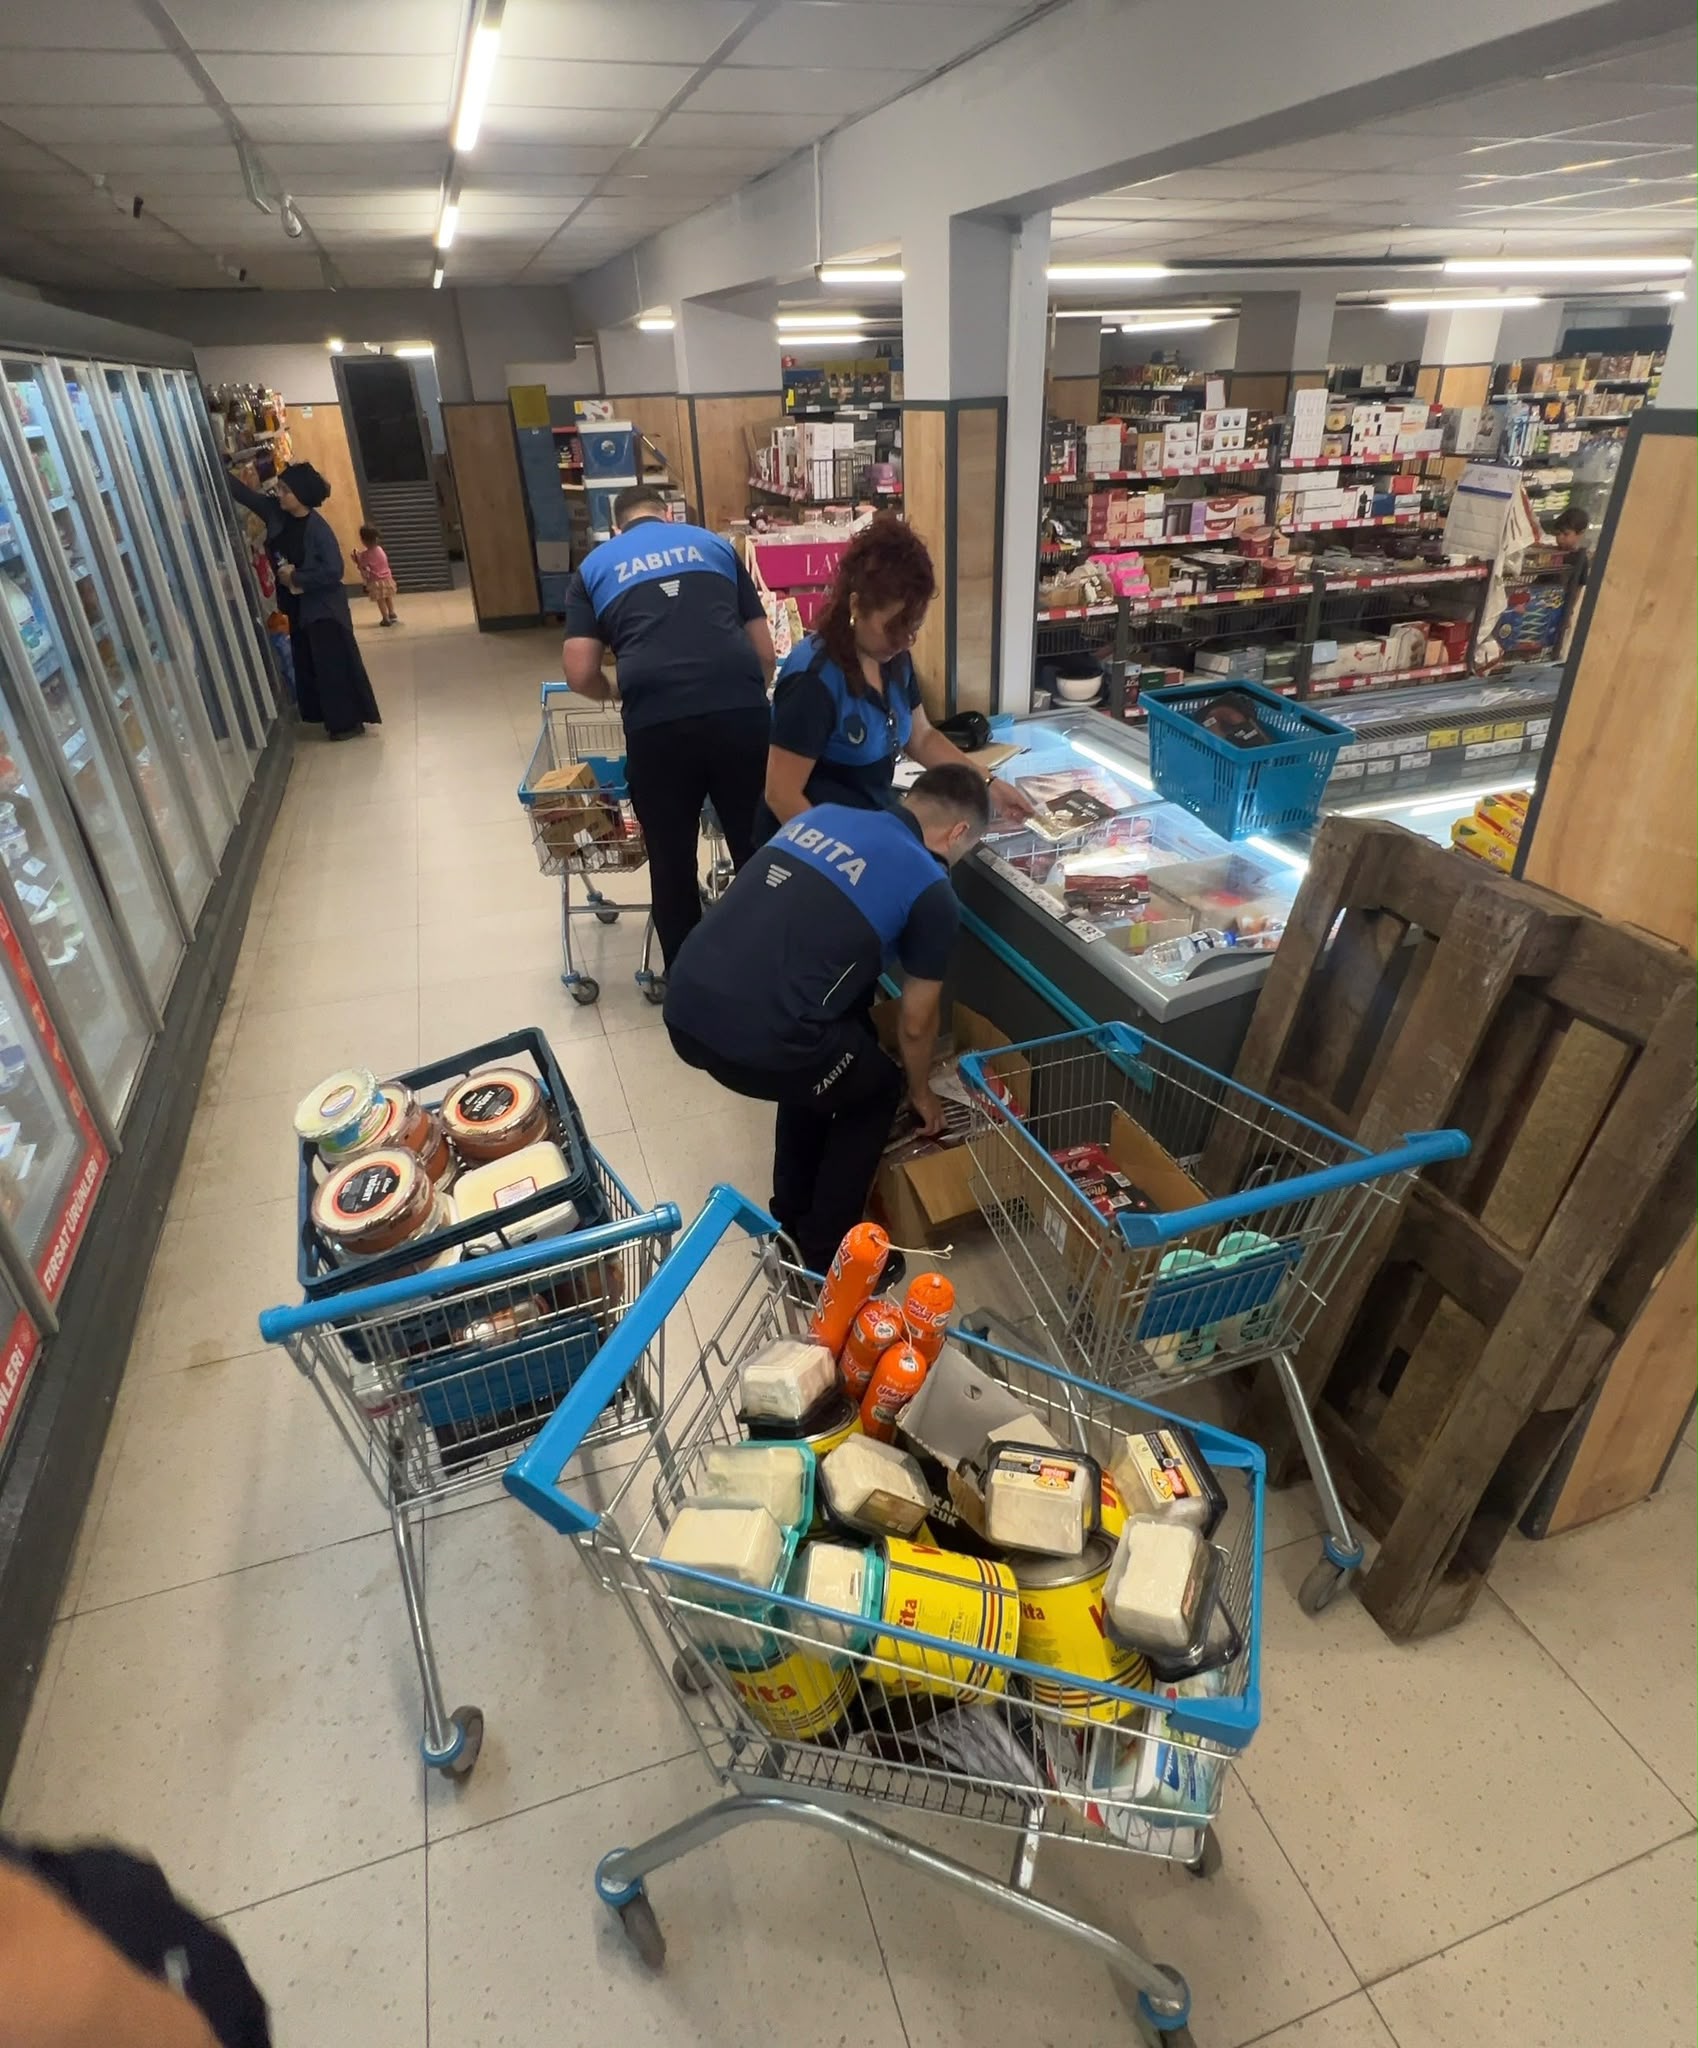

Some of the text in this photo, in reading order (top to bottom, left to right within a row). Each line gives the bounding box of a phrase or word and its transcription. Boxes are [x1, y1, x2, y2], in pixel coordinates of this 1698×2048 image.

[614, 546, 704, 583] ZABITA
[782, 822, 867, 887] ABITA
[812, 1052, 854, 1095] ZABITA
[43, 1225, 71, 1292] FIRSAT
[0, 1343, 25, 1424] NLERİ
